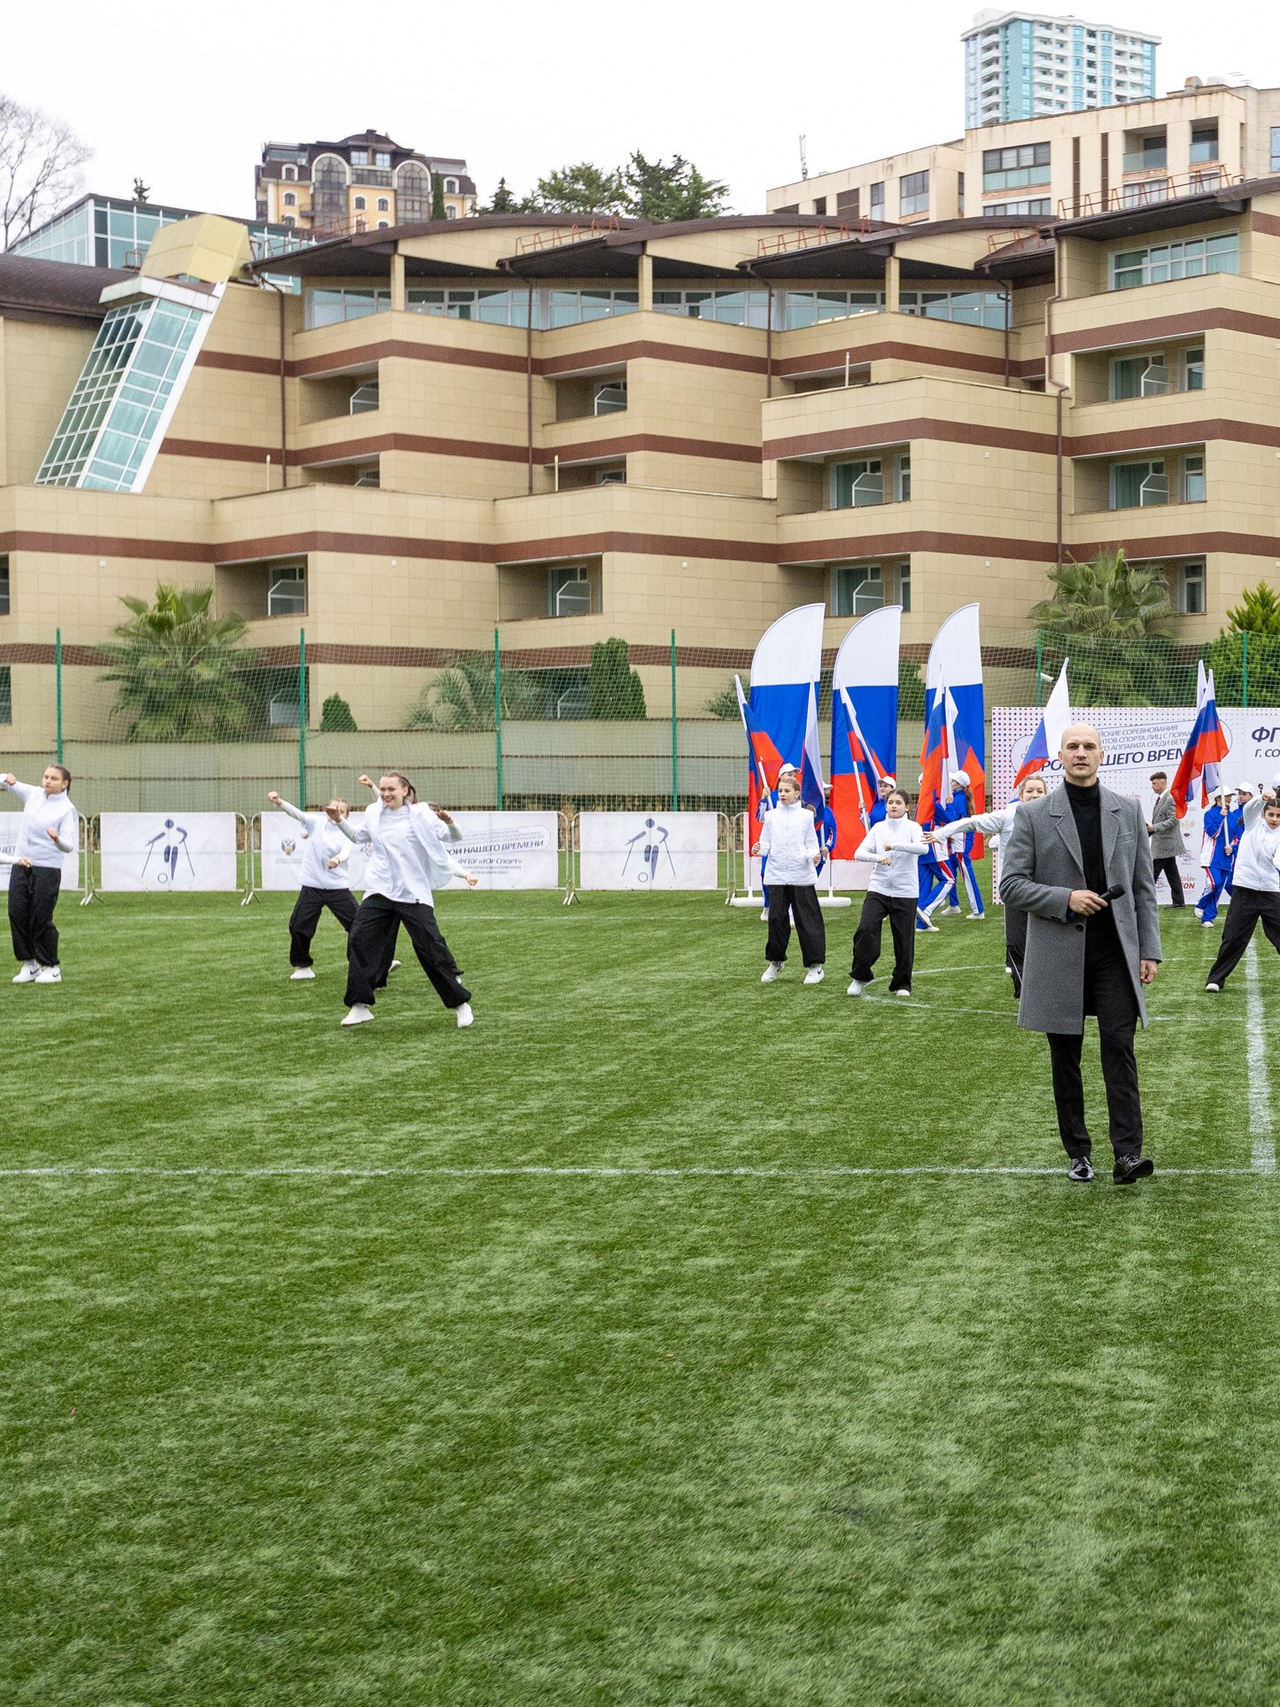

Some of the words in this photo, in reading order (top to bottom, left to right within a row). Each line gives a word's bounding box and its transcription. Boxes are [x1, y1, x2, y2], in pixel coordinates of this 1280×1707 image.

[1122, 724, 1178, 736] СОРЕВНОВАНИЯ
[1119, 735, 1145, 744] СПОРТА
[1146, 733, 1162, 742] ЛИЦ
[1111, 742, 1146, 751] АППАРАТА
[1147, 739, 1170, 748] СРЕДИ
[1100, 751, 1144, 766] ШЕГО
[463, 844, 500, 854] НАШЕГО
[501, 840, 544, 850] ВРЕМЕНИ
